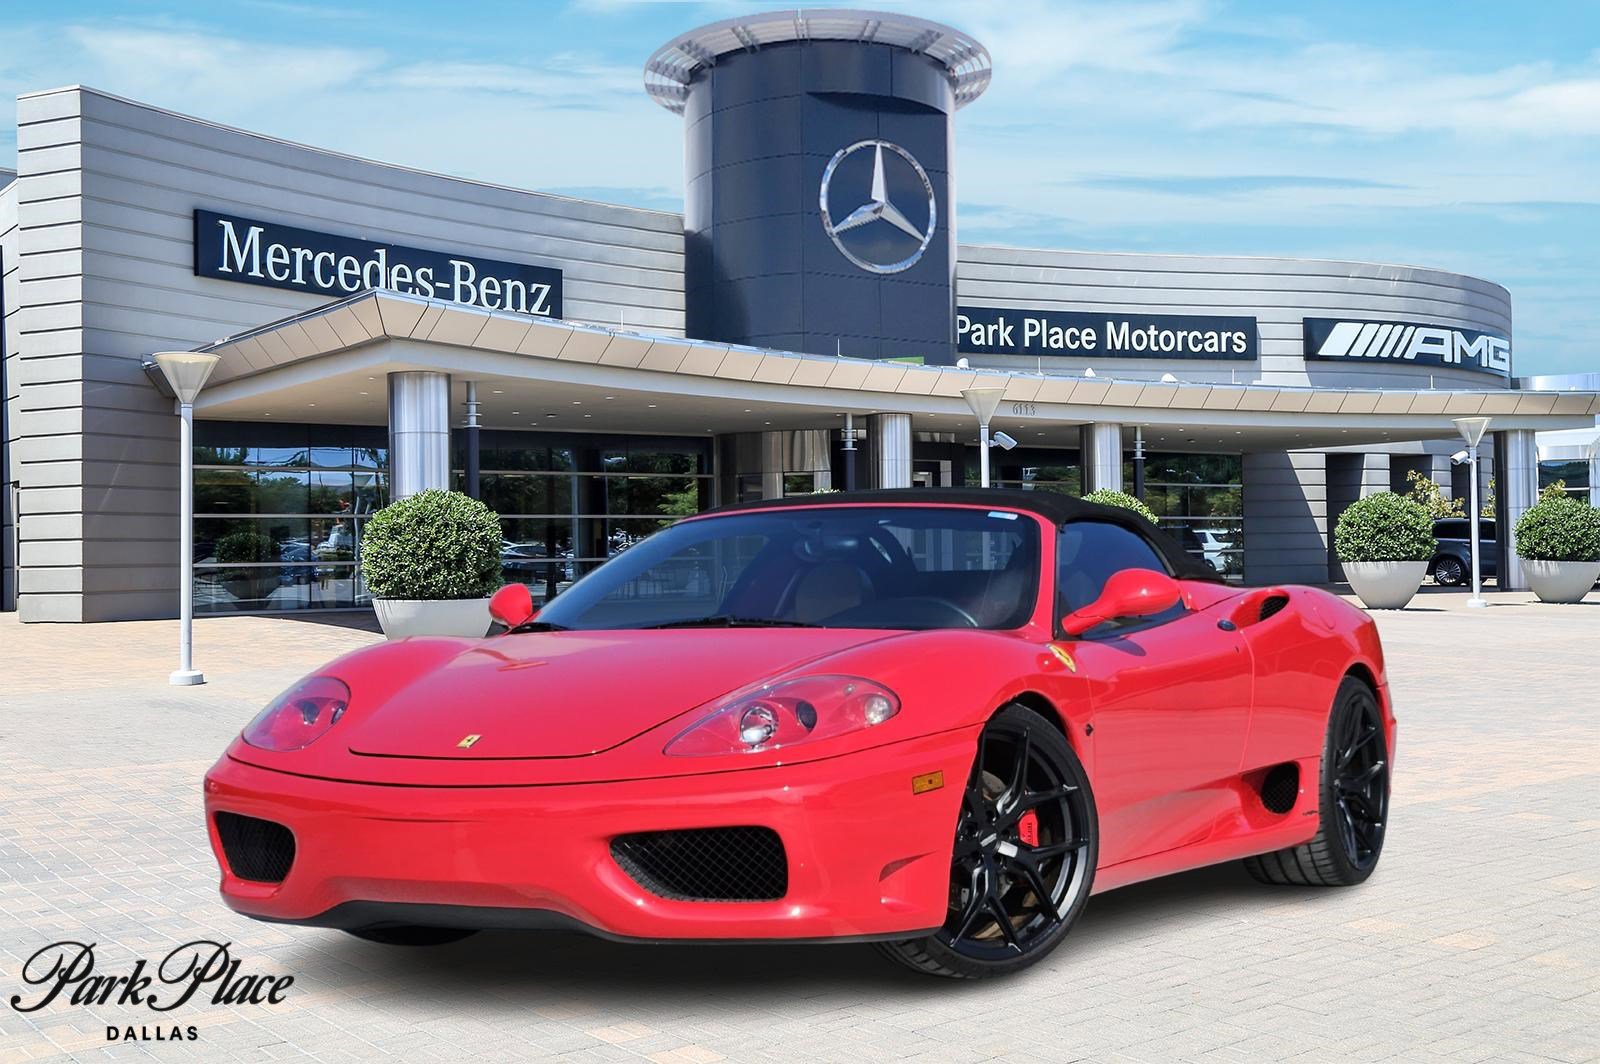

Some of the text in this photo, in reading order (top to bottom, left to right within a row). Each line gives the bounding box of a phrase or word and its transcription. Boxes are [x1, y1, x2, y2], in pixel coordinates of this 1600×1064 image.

[217, 219, 552, 316] Mercedes-Benz
[957, 315, 1247, 353] Park Place Motorcars
[1403, 326, 1510, 373] AMG
[1012, 403, 1036, 416] 6113
